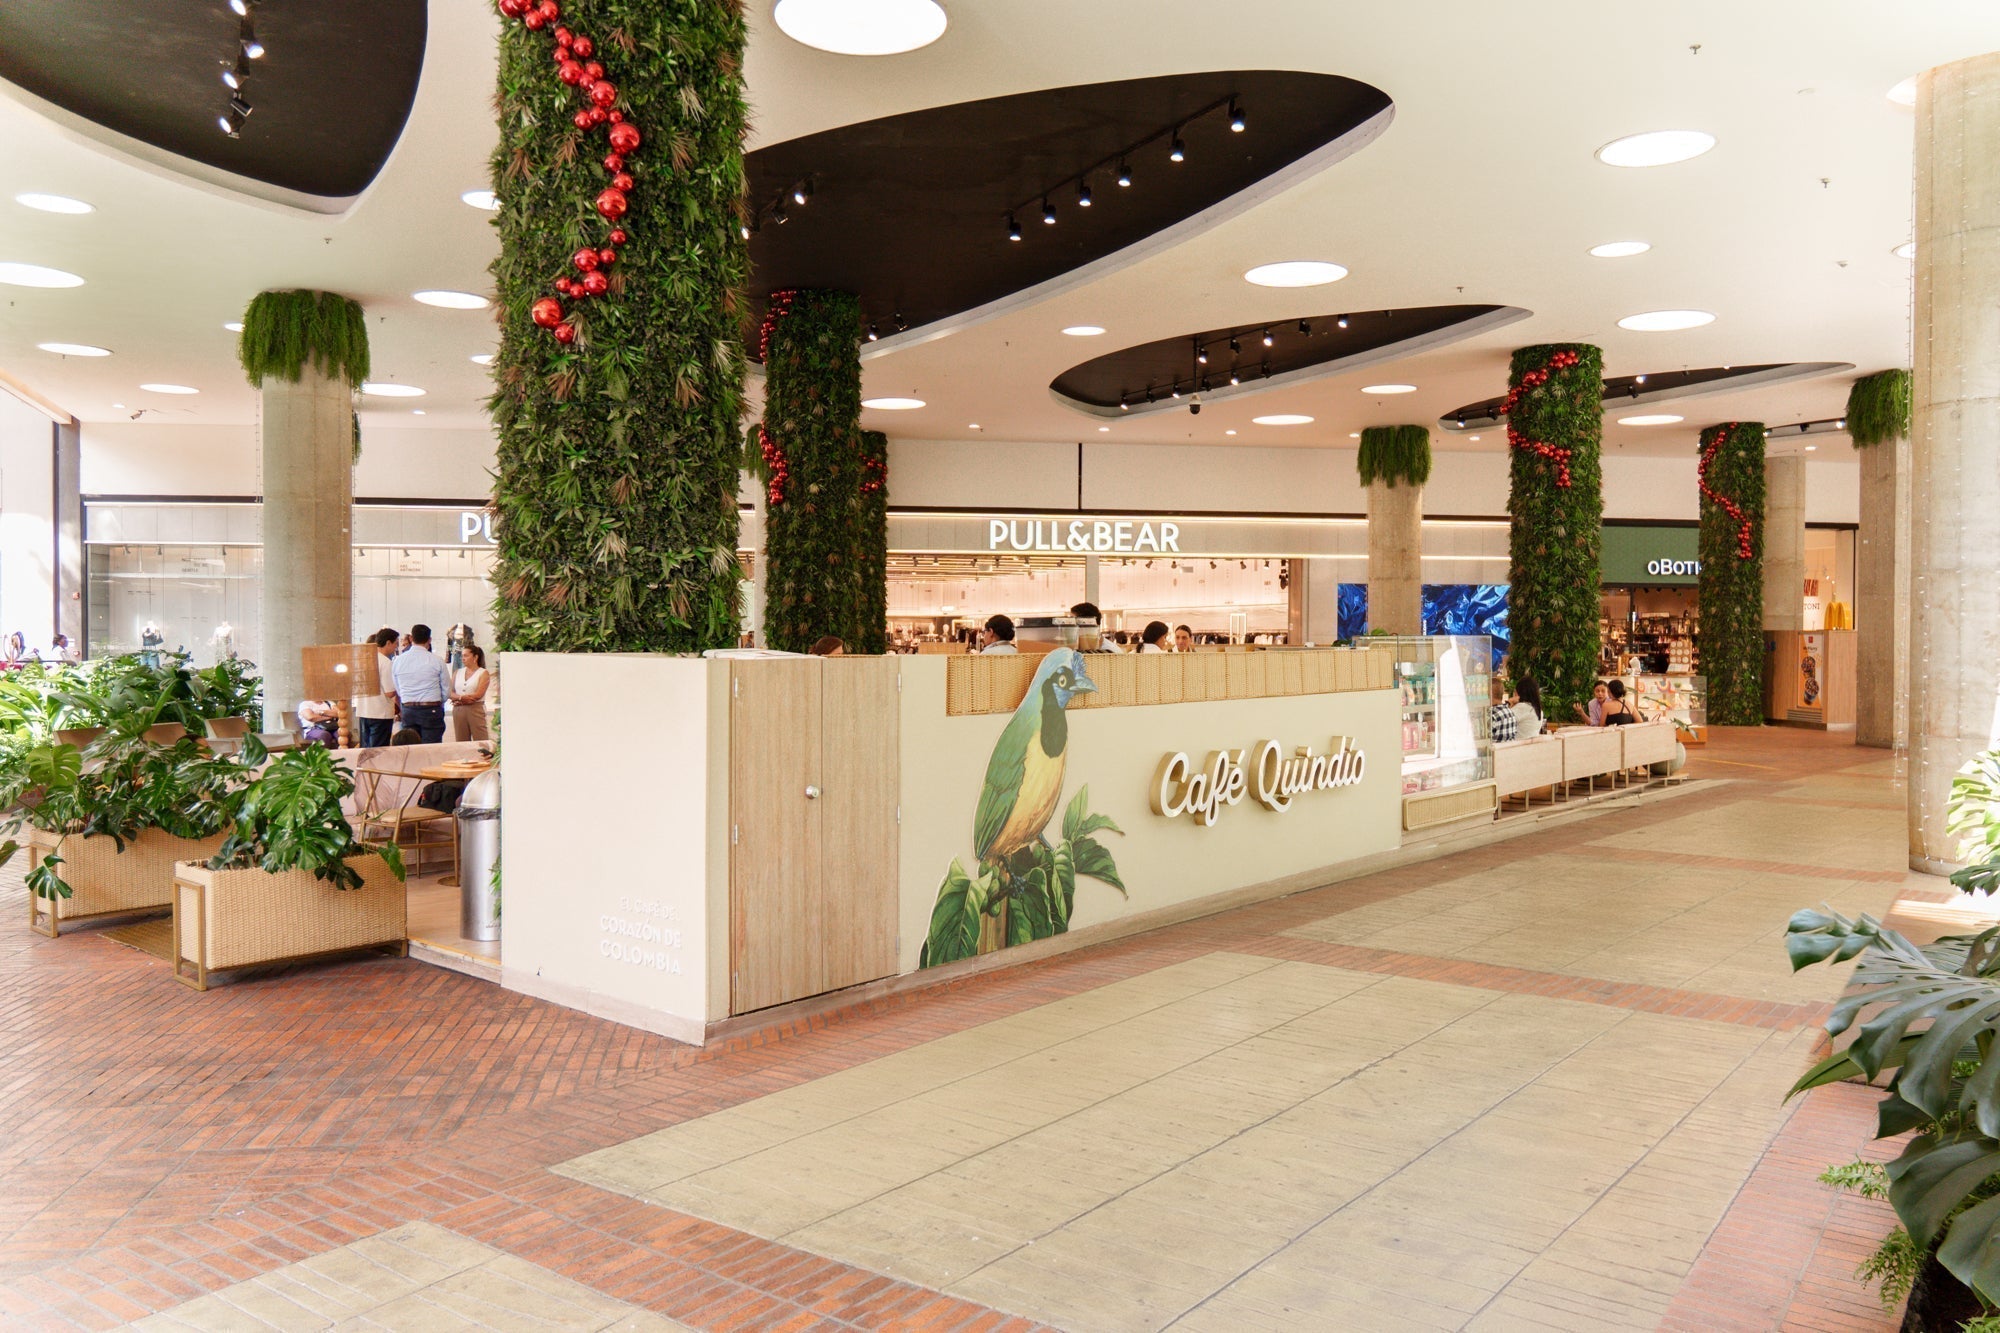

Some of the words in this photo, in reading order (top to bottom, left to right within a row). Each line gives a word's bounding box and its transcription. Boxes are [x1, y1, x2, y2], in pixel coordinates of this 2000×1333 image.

[989, 519, 1180, 552] PULL&BEAR
[1152, 748, 1248, 827] Café
[1251, 735, 1367, 813] Quindío
[600, 914, 662, 945] CORAZÓN
[664, 927, 682, 949] DE
[600, 939, 682, 976] COLOMBIA
